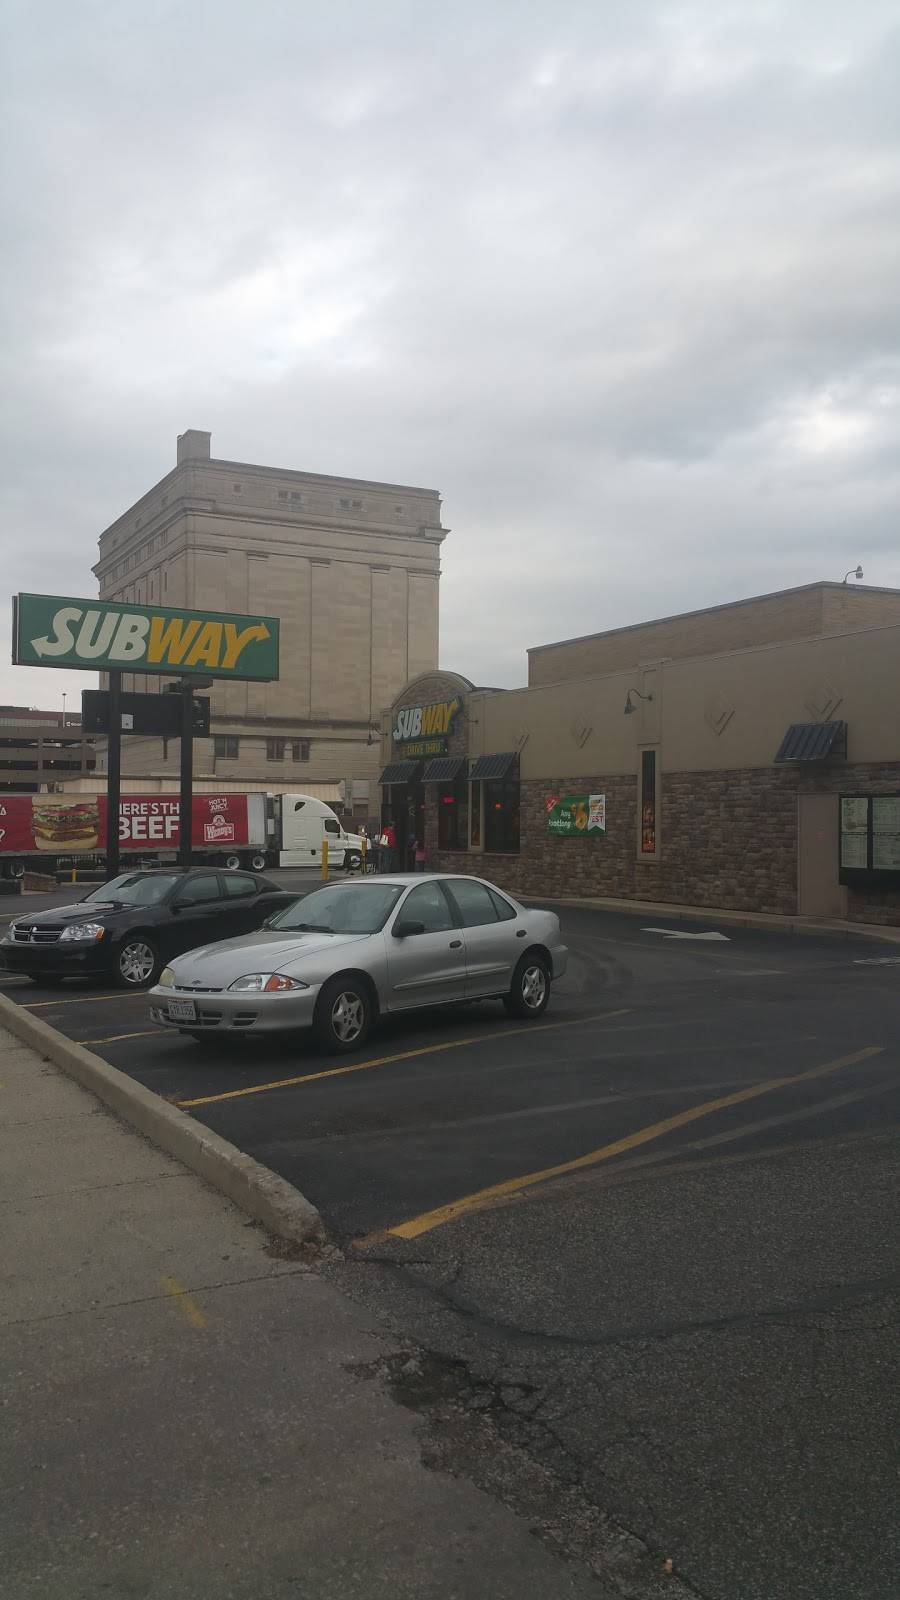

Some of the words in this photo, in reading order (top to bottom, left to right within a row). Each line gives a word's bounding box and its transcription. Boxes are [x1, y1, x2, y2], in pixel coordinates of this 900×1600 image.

[30, 607, 271, 669] SUBWAY
[392, 698, 458, 740] SUBWAY
[119, 803, 159, 815] ERE'S
[160, 802, 180, 815] TH
[560, 809, 571, 819] Any
[119, 816, 180, 840] BEEF
